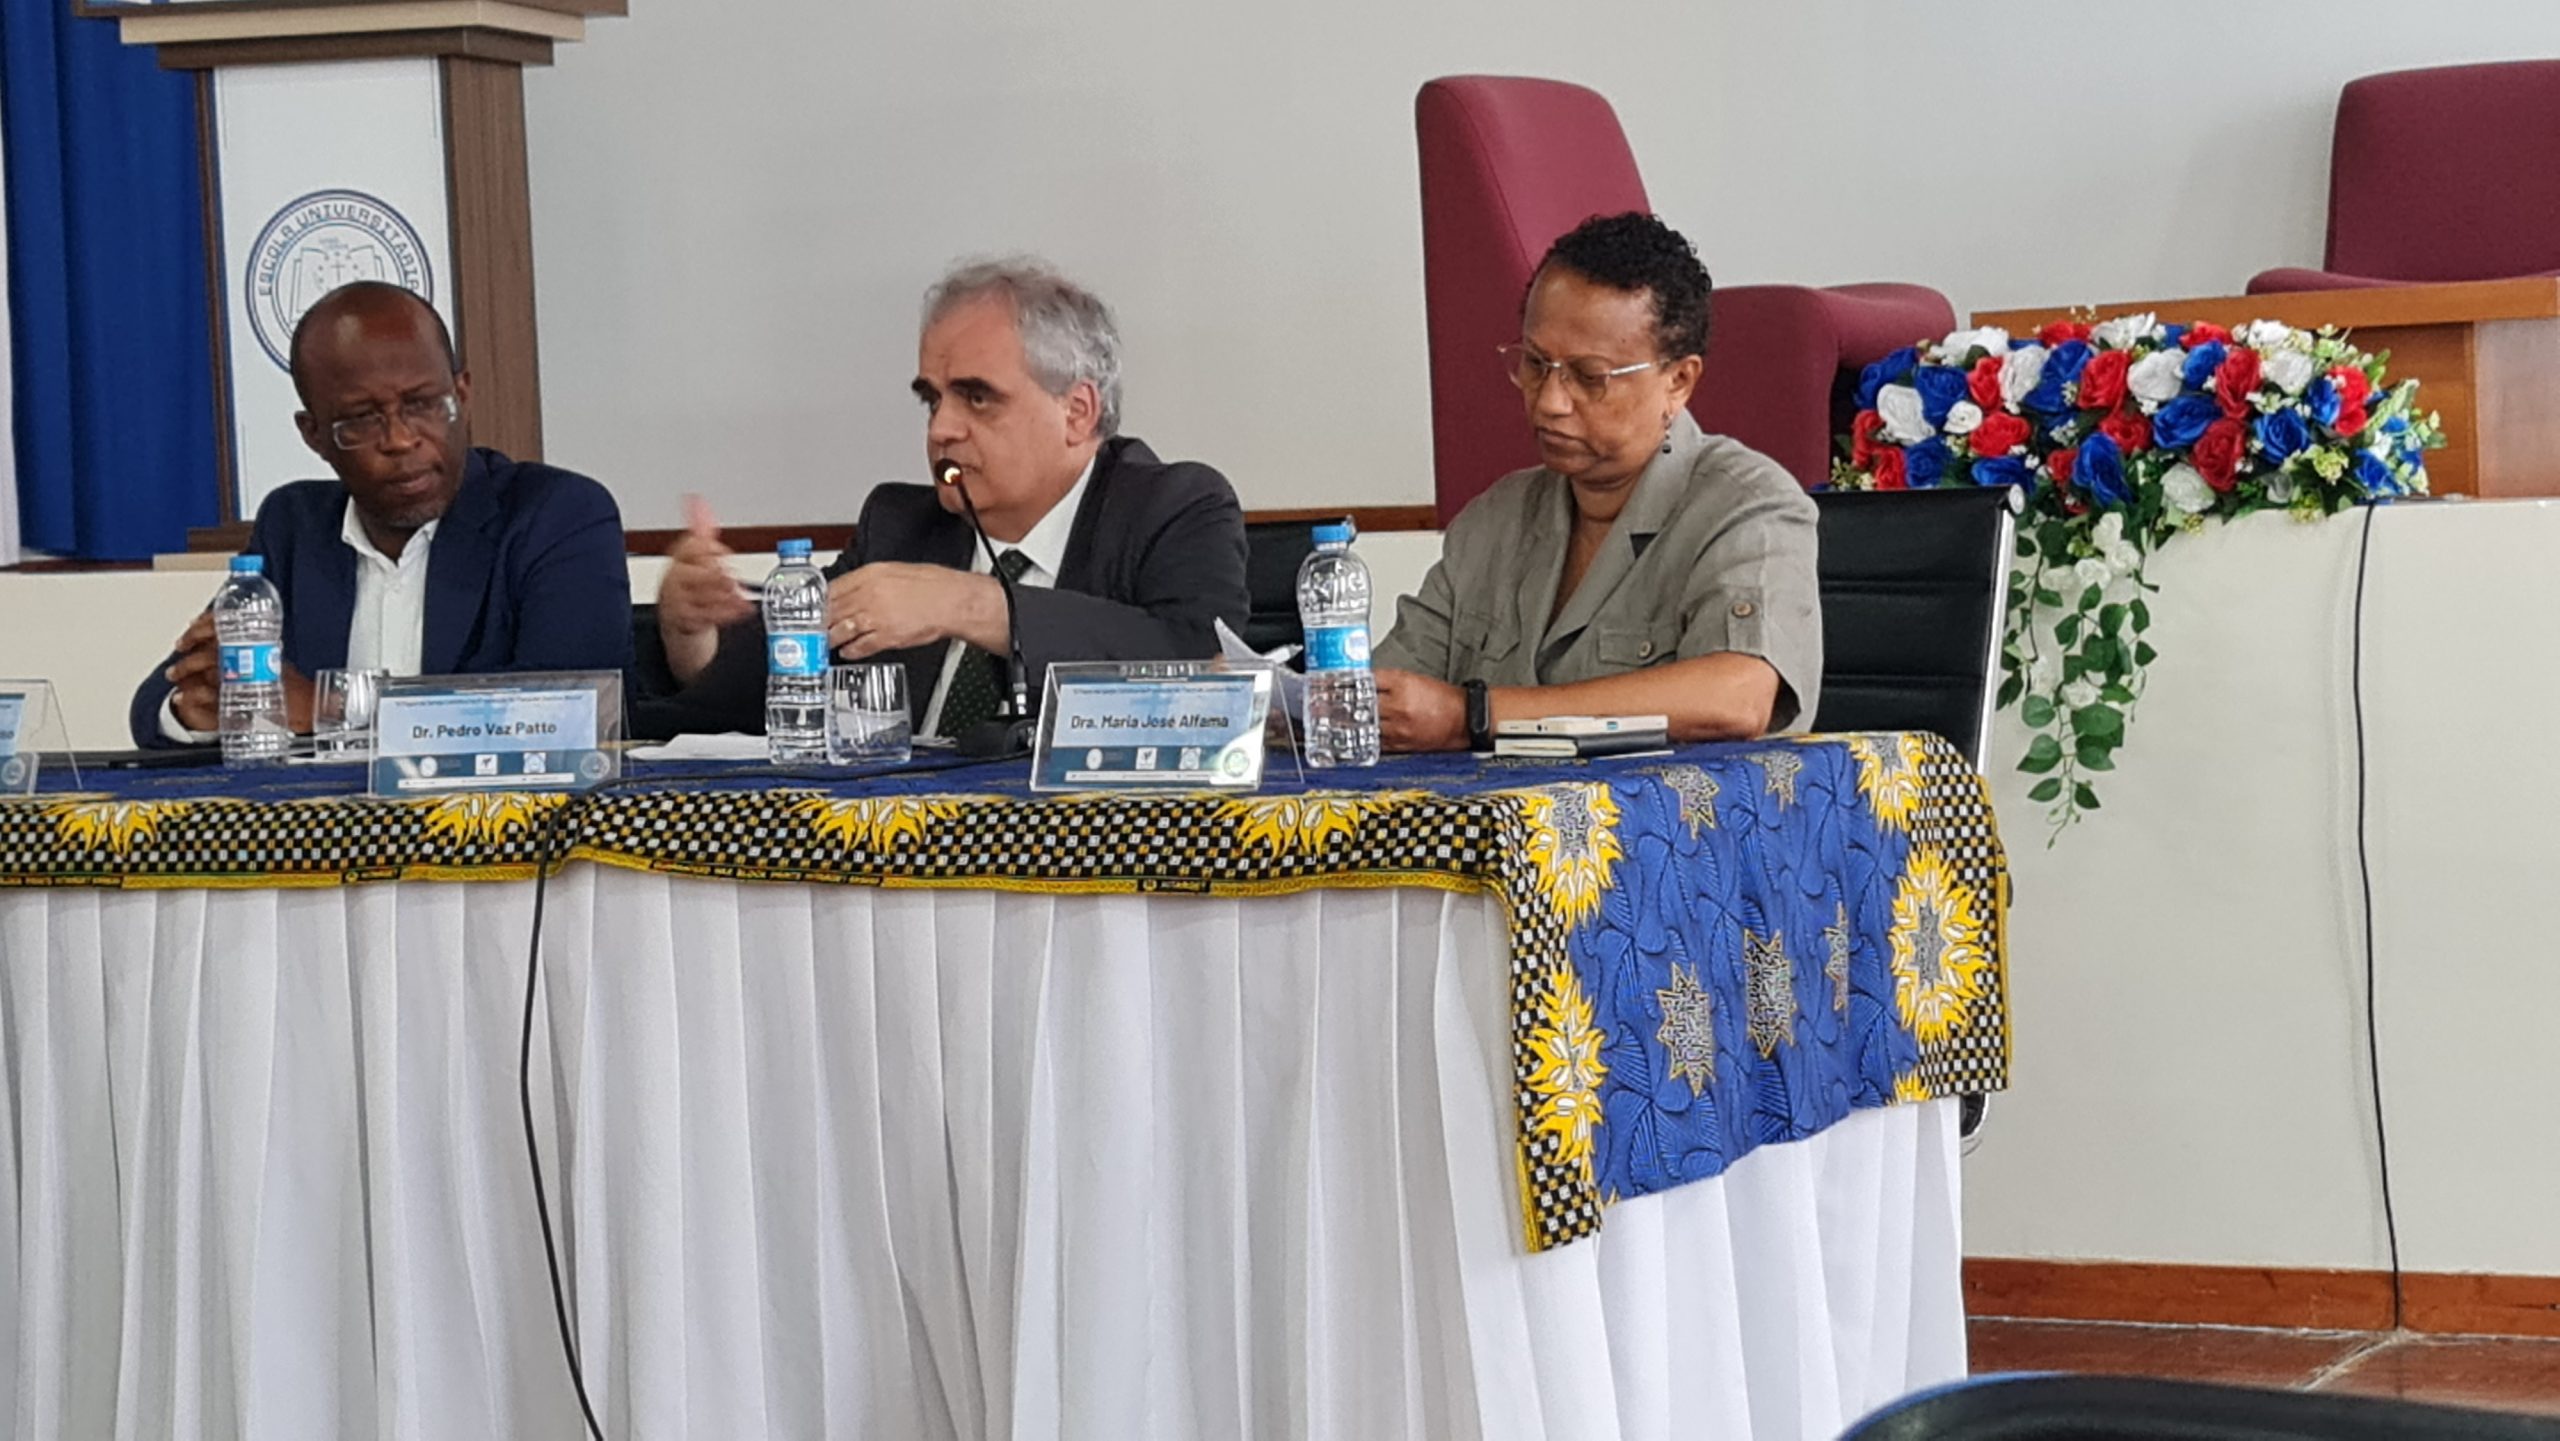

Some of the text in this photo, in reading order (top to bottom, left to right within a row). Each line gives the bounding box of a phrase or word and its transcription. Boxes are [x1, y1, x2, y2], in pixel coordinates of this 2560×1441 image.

[258, 224, 295, 297] ESCOLA
[412, 721, 557, 739] Dr. Pedro Vaz Patto
[1070, 713, 1229, 729] Dra. Maria José Alfama
